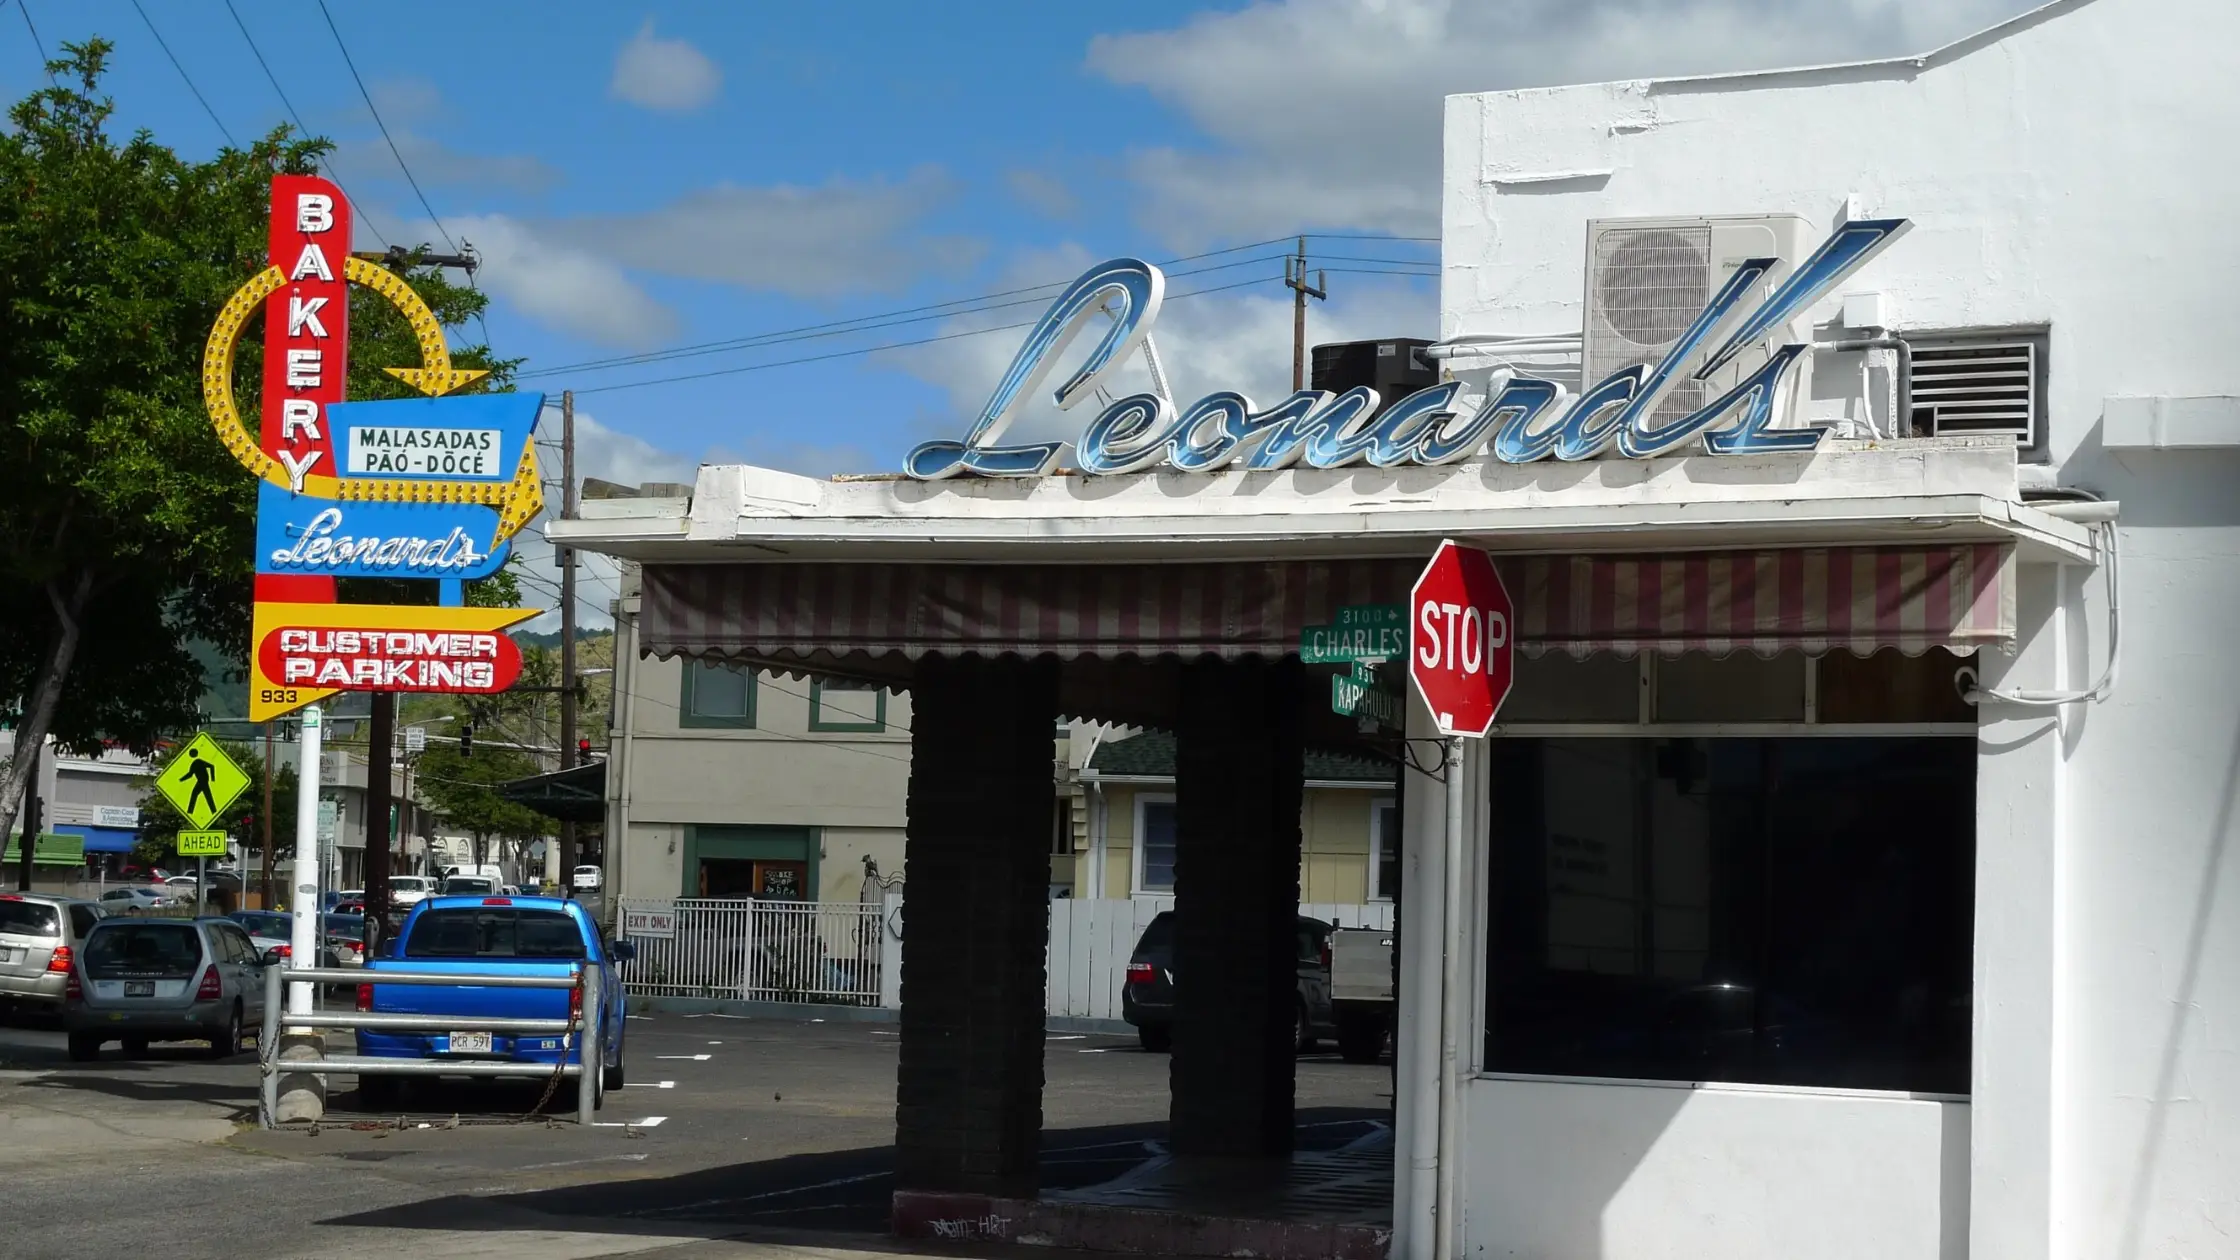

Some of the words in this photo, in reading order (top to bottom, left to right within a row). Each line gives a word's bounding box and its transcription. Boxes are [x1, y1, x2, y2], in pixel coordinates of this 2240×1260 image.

[277, 193, 334, 491] BAKERY
[902, 218, 1914, 481] Leonard's
[360, 428, 491, 450] MALASADAS
[1343, 609, 1382, 624] 3100
[280, 629, 498, 658] CUSTOMER
[1313, 627, 1404, 658] CHARLES
[1419, 600, 1507, 676] STOP
[285, 657, 494, 688] PARKING
[261, 690, 297, 703] 933
[183, 836, 221, 850] AHEAD
[628, 915, 647, 928] EXIT
[651, 916, 672, 929] ONLY
[451, 1035, 468, 1048] PCR
[473, 1035, 490, 1049] 597
